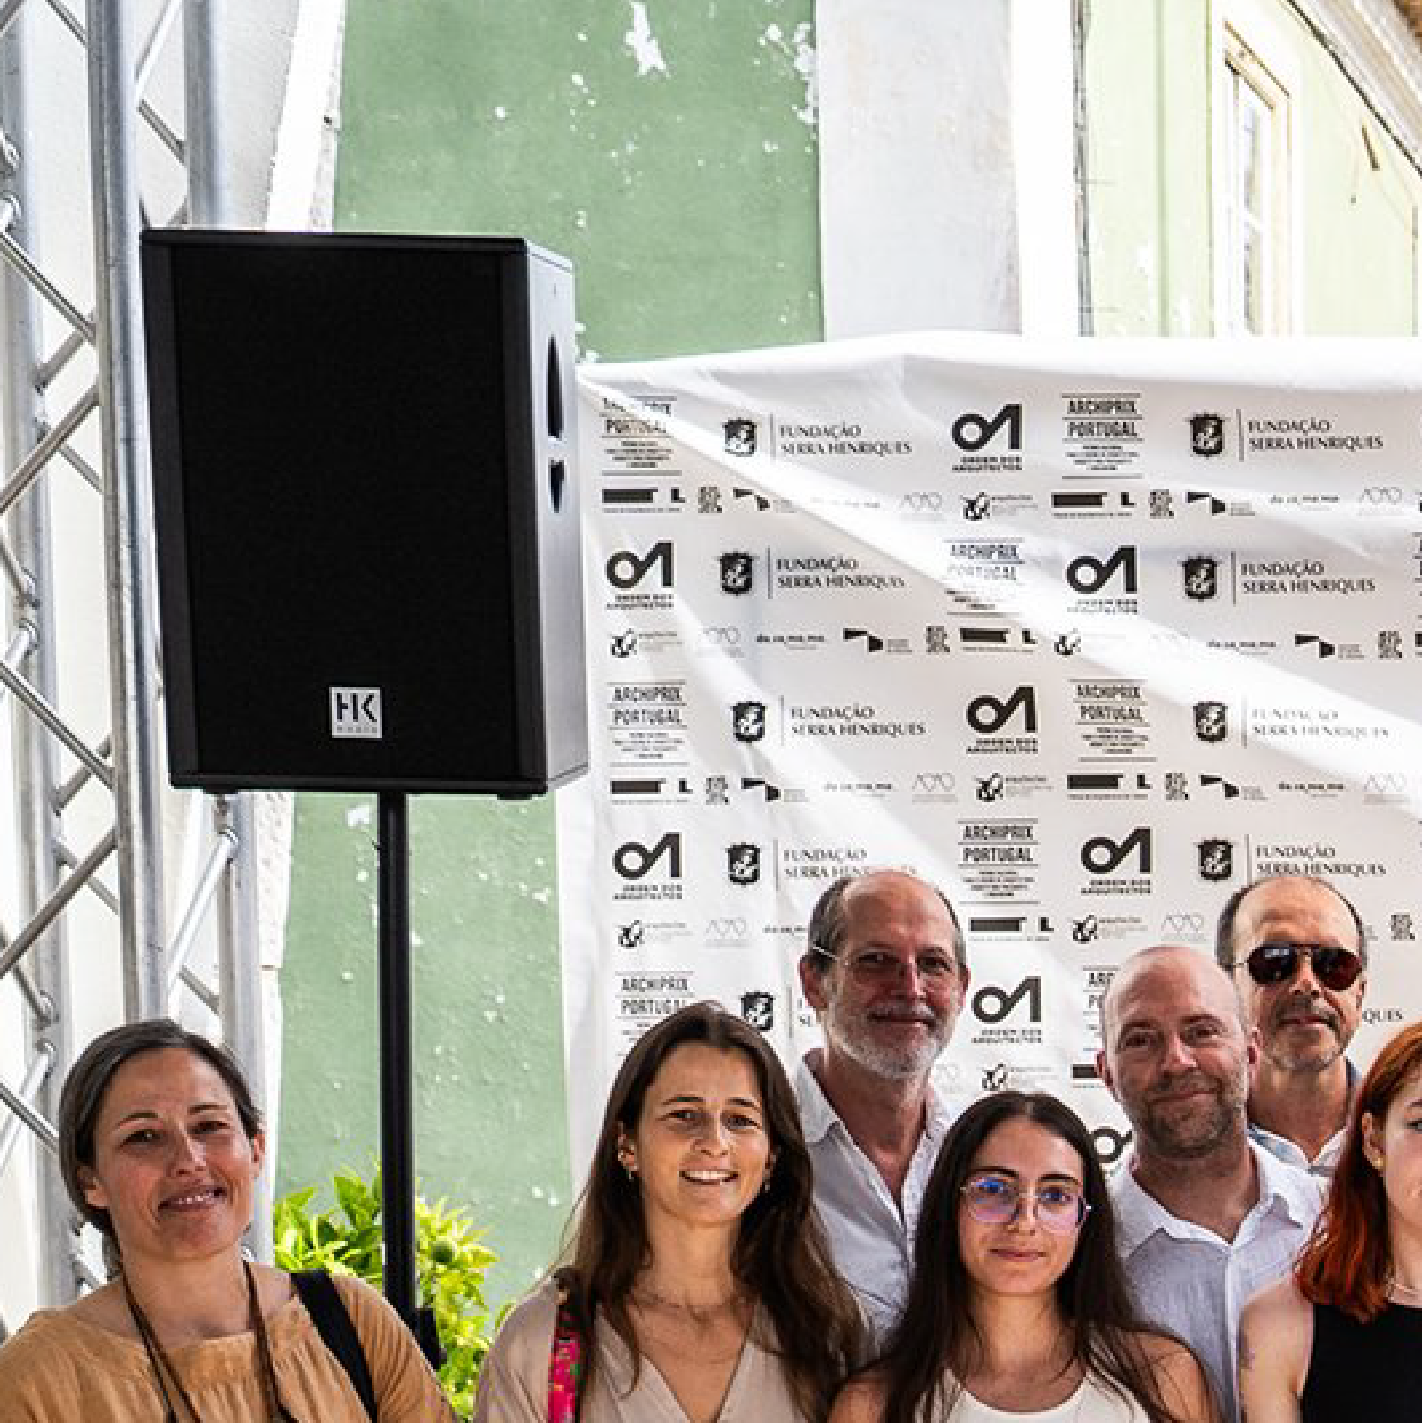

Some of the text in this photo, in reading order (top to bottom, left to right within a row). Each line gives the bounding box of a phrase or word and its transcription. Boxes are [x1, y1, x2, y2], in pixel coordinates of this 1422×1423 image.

[1068, 401, 1137, 414] ARCHIPRIX
[1068, 422, 1137, 438] PORTUGAL
[614, 688, 681, 700] ARCHIPRIX
[1077, 685, 1140, 698] ARCHIPRIX
[337, 693, 377, 722] HK
[1080, 706, 1143, 722] PORTUGAL
[614, 708, 681, 724] PORTUGAL
[964, 826, 1033, 840] ARCHIPRIX
[964, 848, 1033, 862] PORTUGAL
